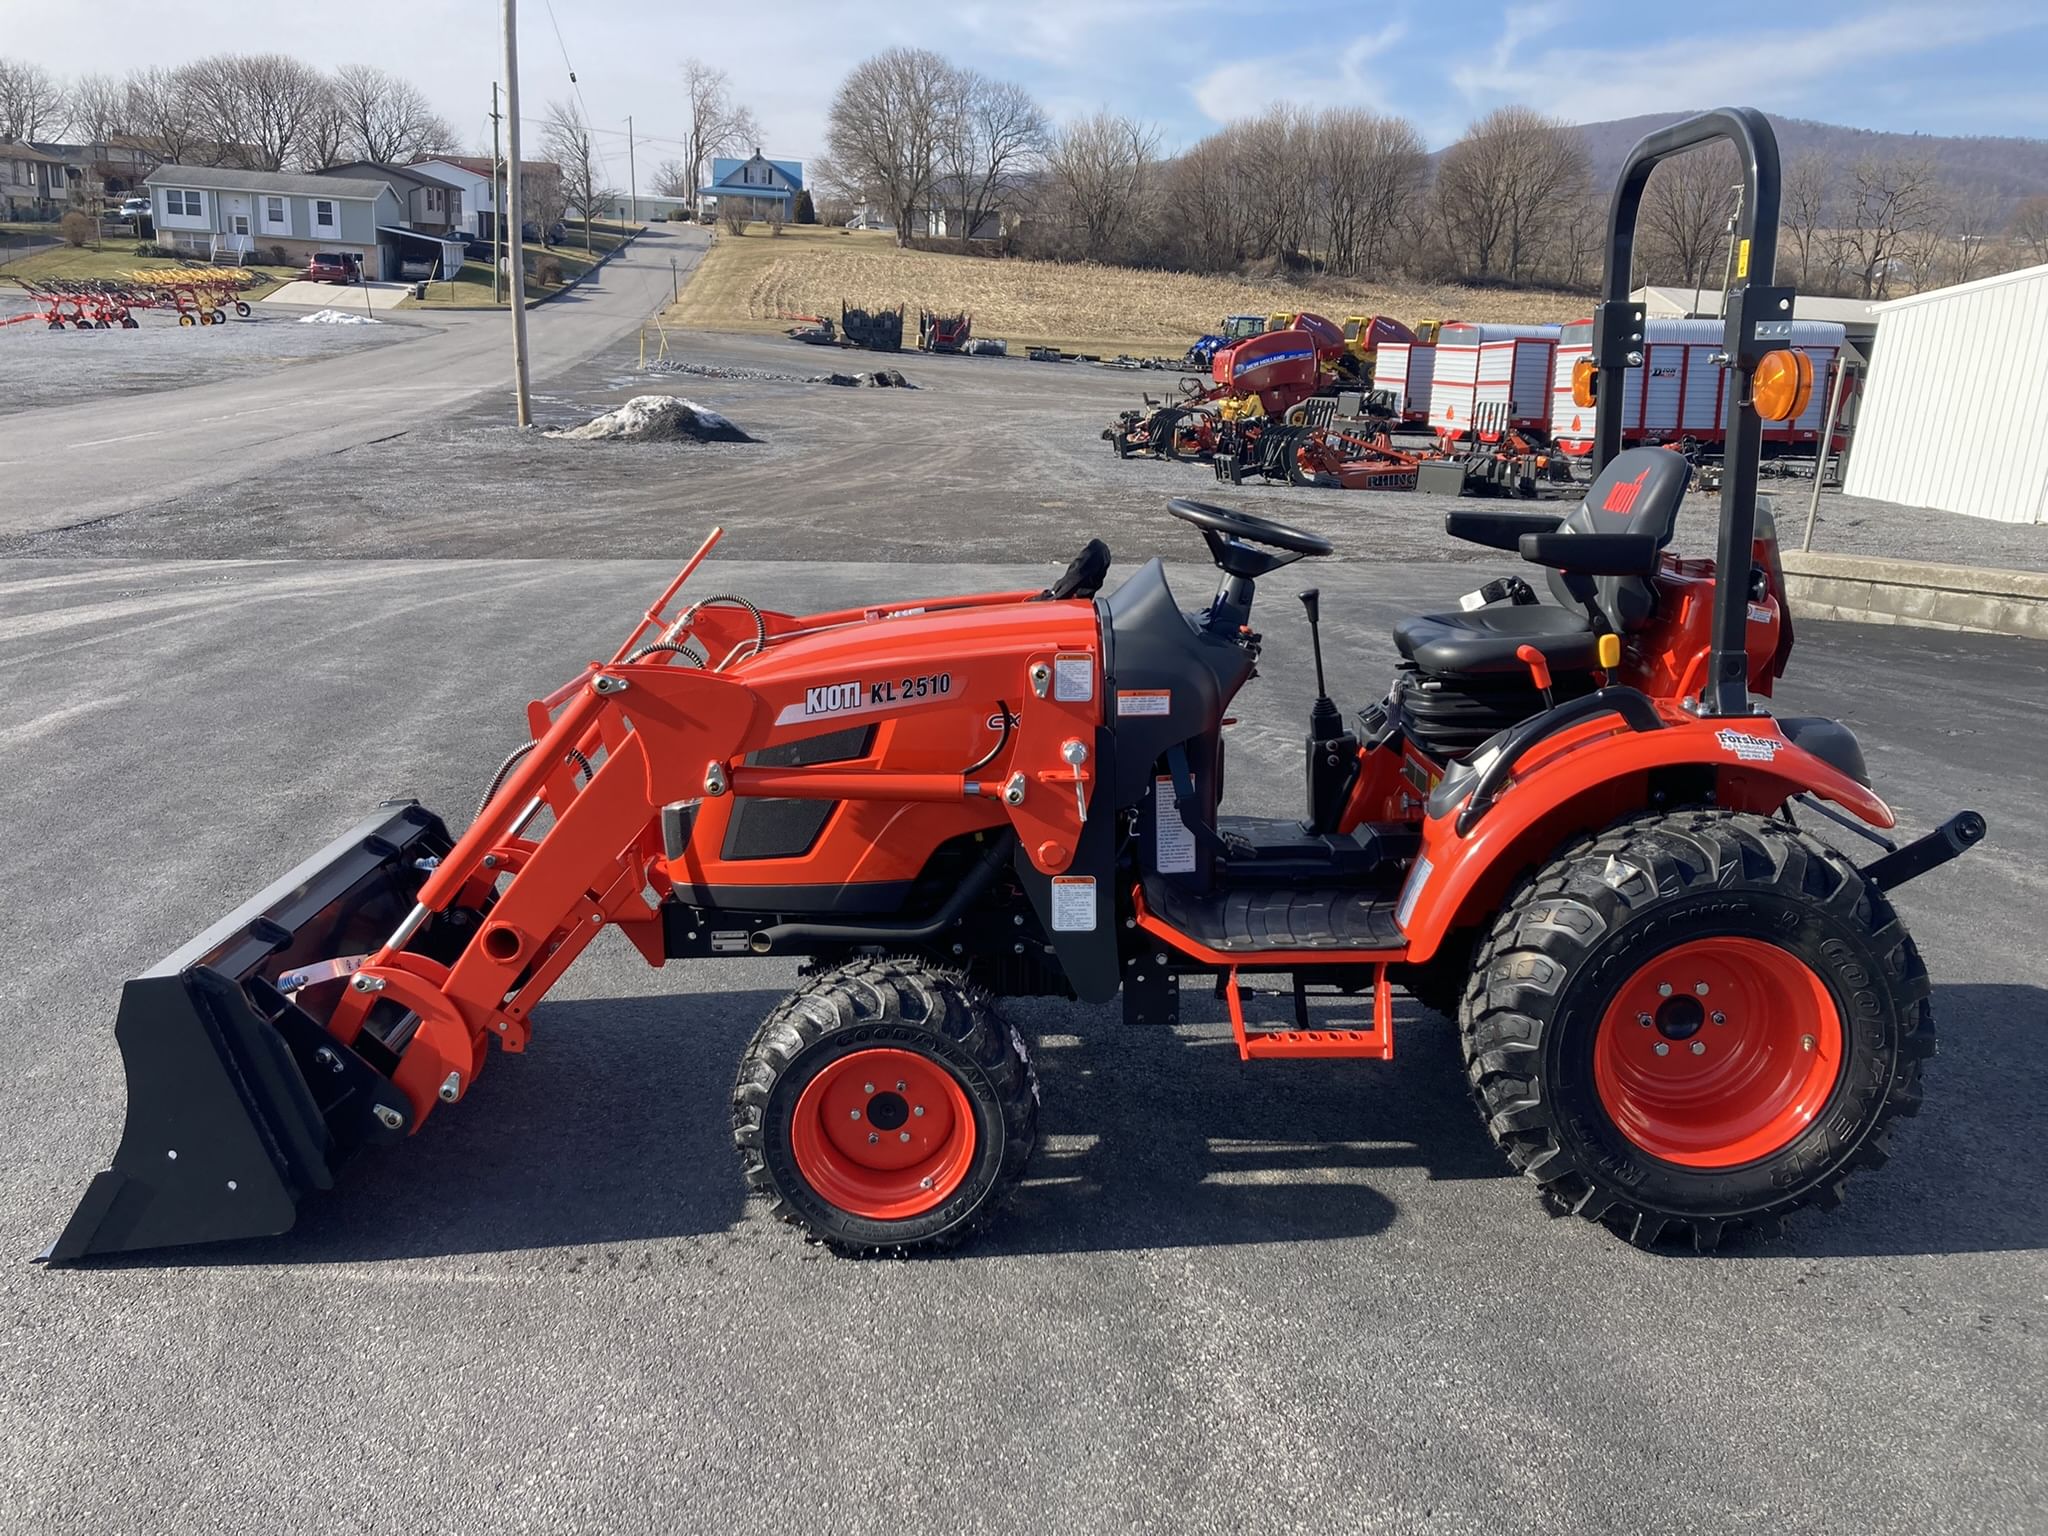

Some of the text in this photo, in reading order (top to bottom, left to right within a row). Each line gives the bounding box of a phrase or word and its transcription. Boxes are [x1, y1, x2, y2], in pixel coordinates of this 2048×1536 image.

[1246, 361, 1259, 370] NEW
[1260, 354, 1285, 365] HOLLAND
[806, 672, 952, 715] KIOTI KL 2510
[1770, 938, 1887, 1188] GOODYEAR
